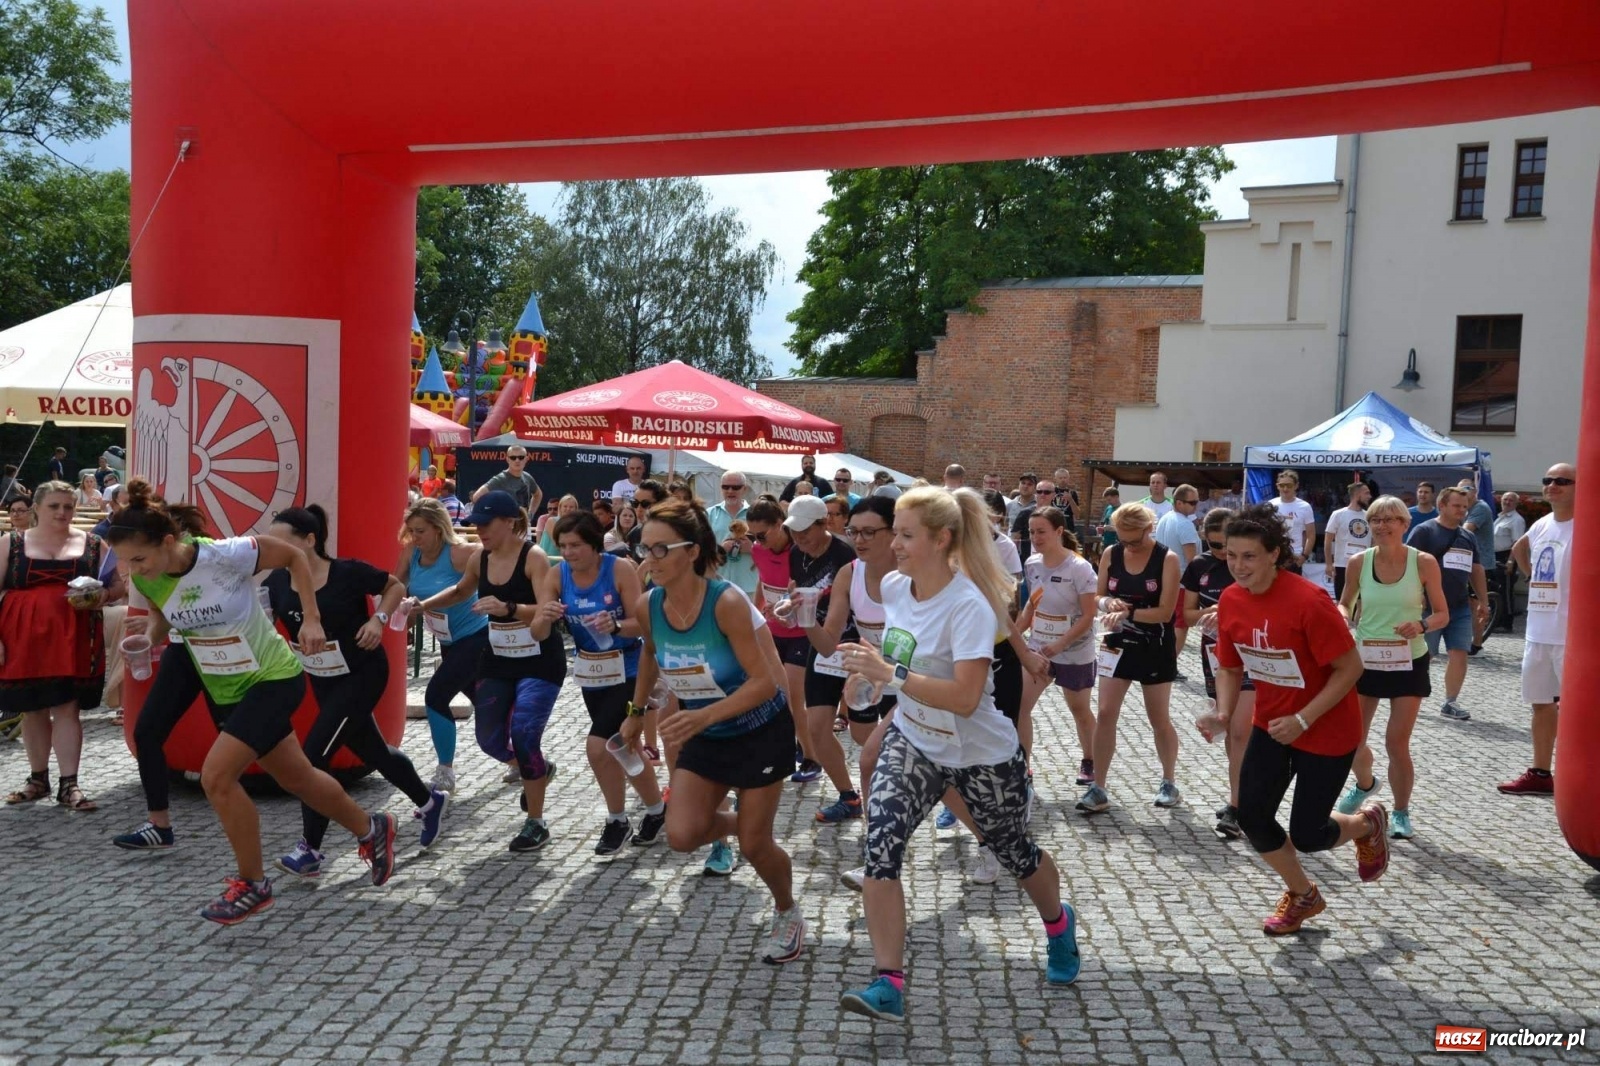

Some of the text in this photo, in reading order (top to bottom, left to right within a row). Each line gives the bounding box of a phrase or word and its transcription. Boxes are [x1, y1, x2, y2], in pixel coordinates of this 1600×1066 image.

[523, 415, 609, 428] RACIBORSKIE
[632, 415, 743, 436] RACIBORSKIE
[771, 424, 836, 445] RACIBORSKIE
[576, 453, 596, 463] SKLEP
[1267, 450, 1448, 465] ŚLĄSKI ODDZIAŁ TERENOWY
[170, 603, 223, 621] AKTYWNI
[1044, 622, 1055, 632] 20
[504, 634, 517, 644] 32
[210, 650, 228, 661] 30
[1380, 650, 1392, 659] 19
[310, 656, 324, 666] 29
[589, 664, 603, 674] 40
[1260, 661, 1277, 673] 53
[672, 678, 691, 688] 28
[917, 708, 926, 721] 8
